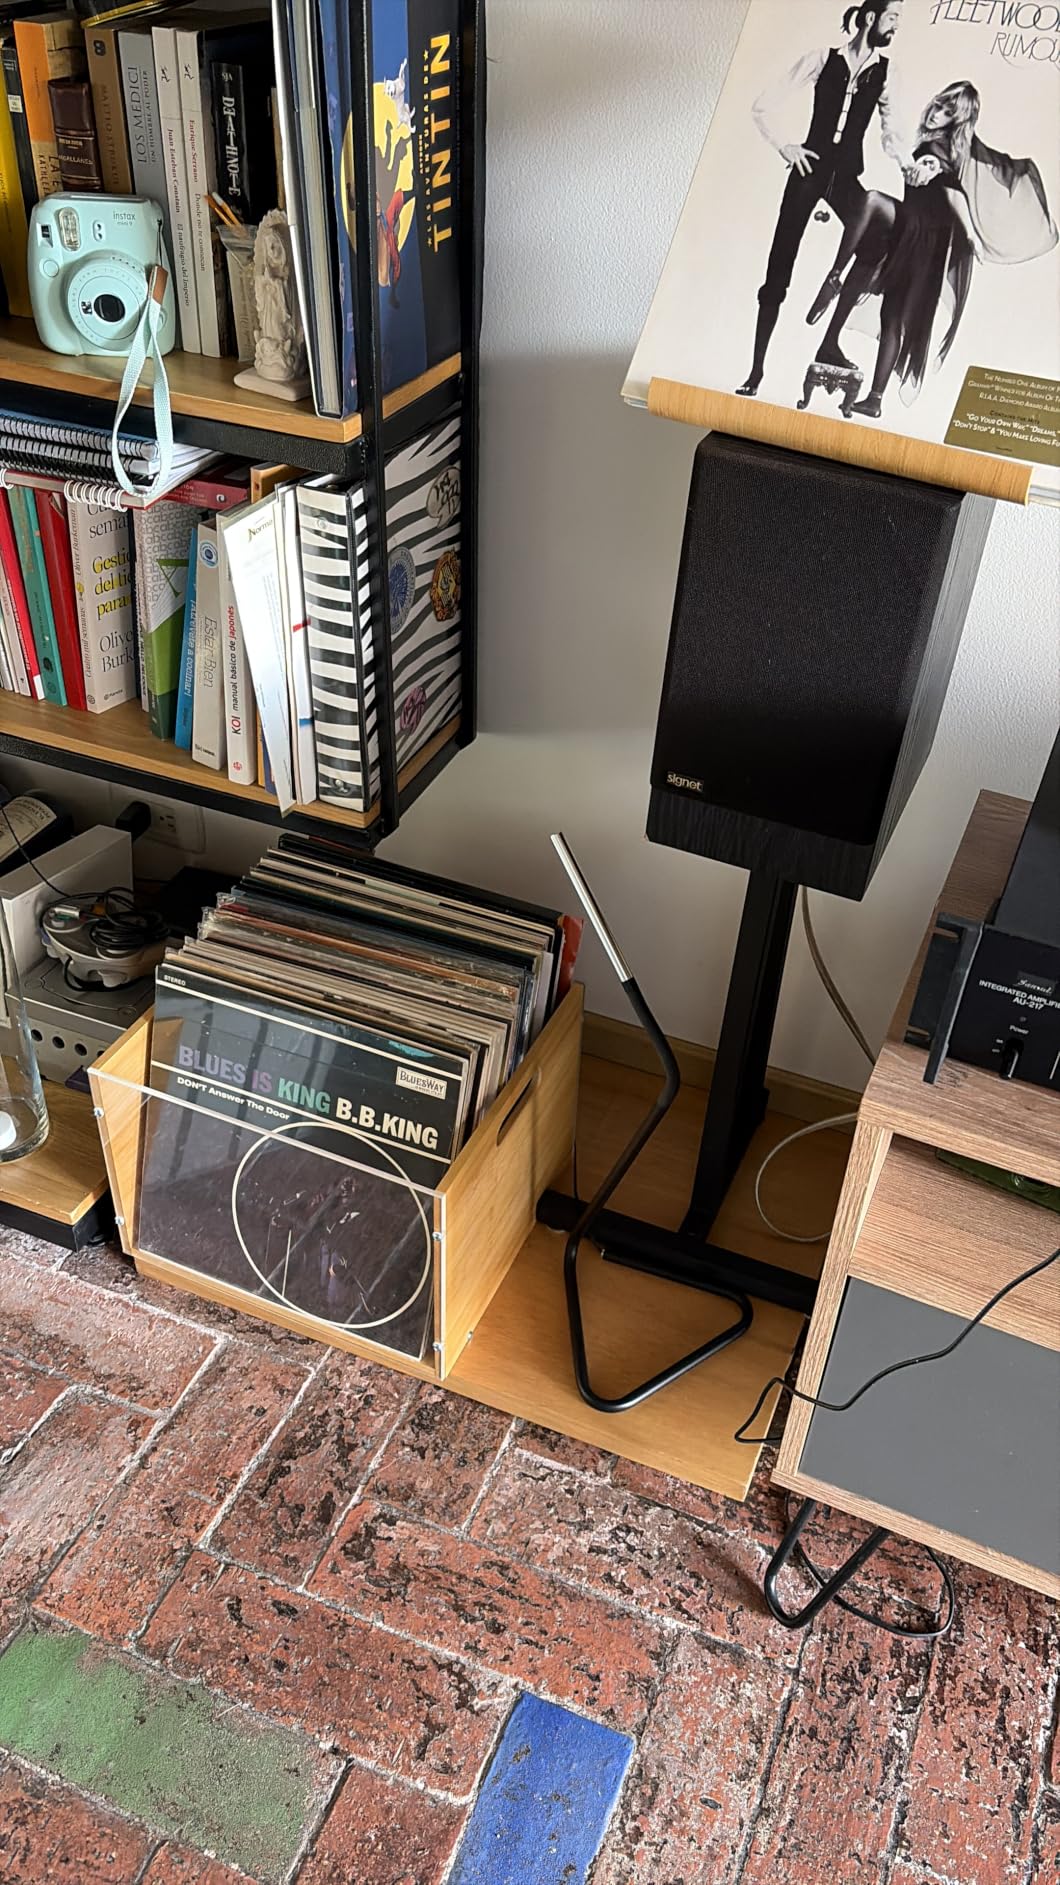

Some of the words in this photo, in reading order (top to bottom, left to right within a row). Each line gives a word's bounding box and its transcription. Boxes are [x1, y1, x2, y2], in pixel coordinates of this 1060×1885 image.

[929, 0, 1060, 32] FLEETWOO
[423, 64, 429, 85] DE
[127, 66, 145, 129] MEDICI
[189, 119, 197, 152] Enrique
[423, 93, 431, 196] AVENTURAS
[430, 33, 452, 253] TINTIN
[134, 134, 147, 163] LOS
[113, 212, 136, 220] instax
[229, 640, 236, 652] de
[229, 681, 238, 712] manual
[232, 715, 241, 735] KOI
[667, 773, 703, 792] signet
[163, 974, 187, 987] STEREO
[978, 979, 1028, 999] INTEGRATED
[1012, 996, 1045, 1010] AU-217
[1009, 1024, 1030, 1035] Power
[178, 1044, 248, 1084] BLUES
[251, 1069, 273, 1093] IS
[278, 1077, 331, 1114] KING
[176, 1076, 208, 1092] DON'T
[208, 1087, 245, 1105] Answer
[246, 1099, 265, 1112] The
[265, 1106, 291, 1121] Door
